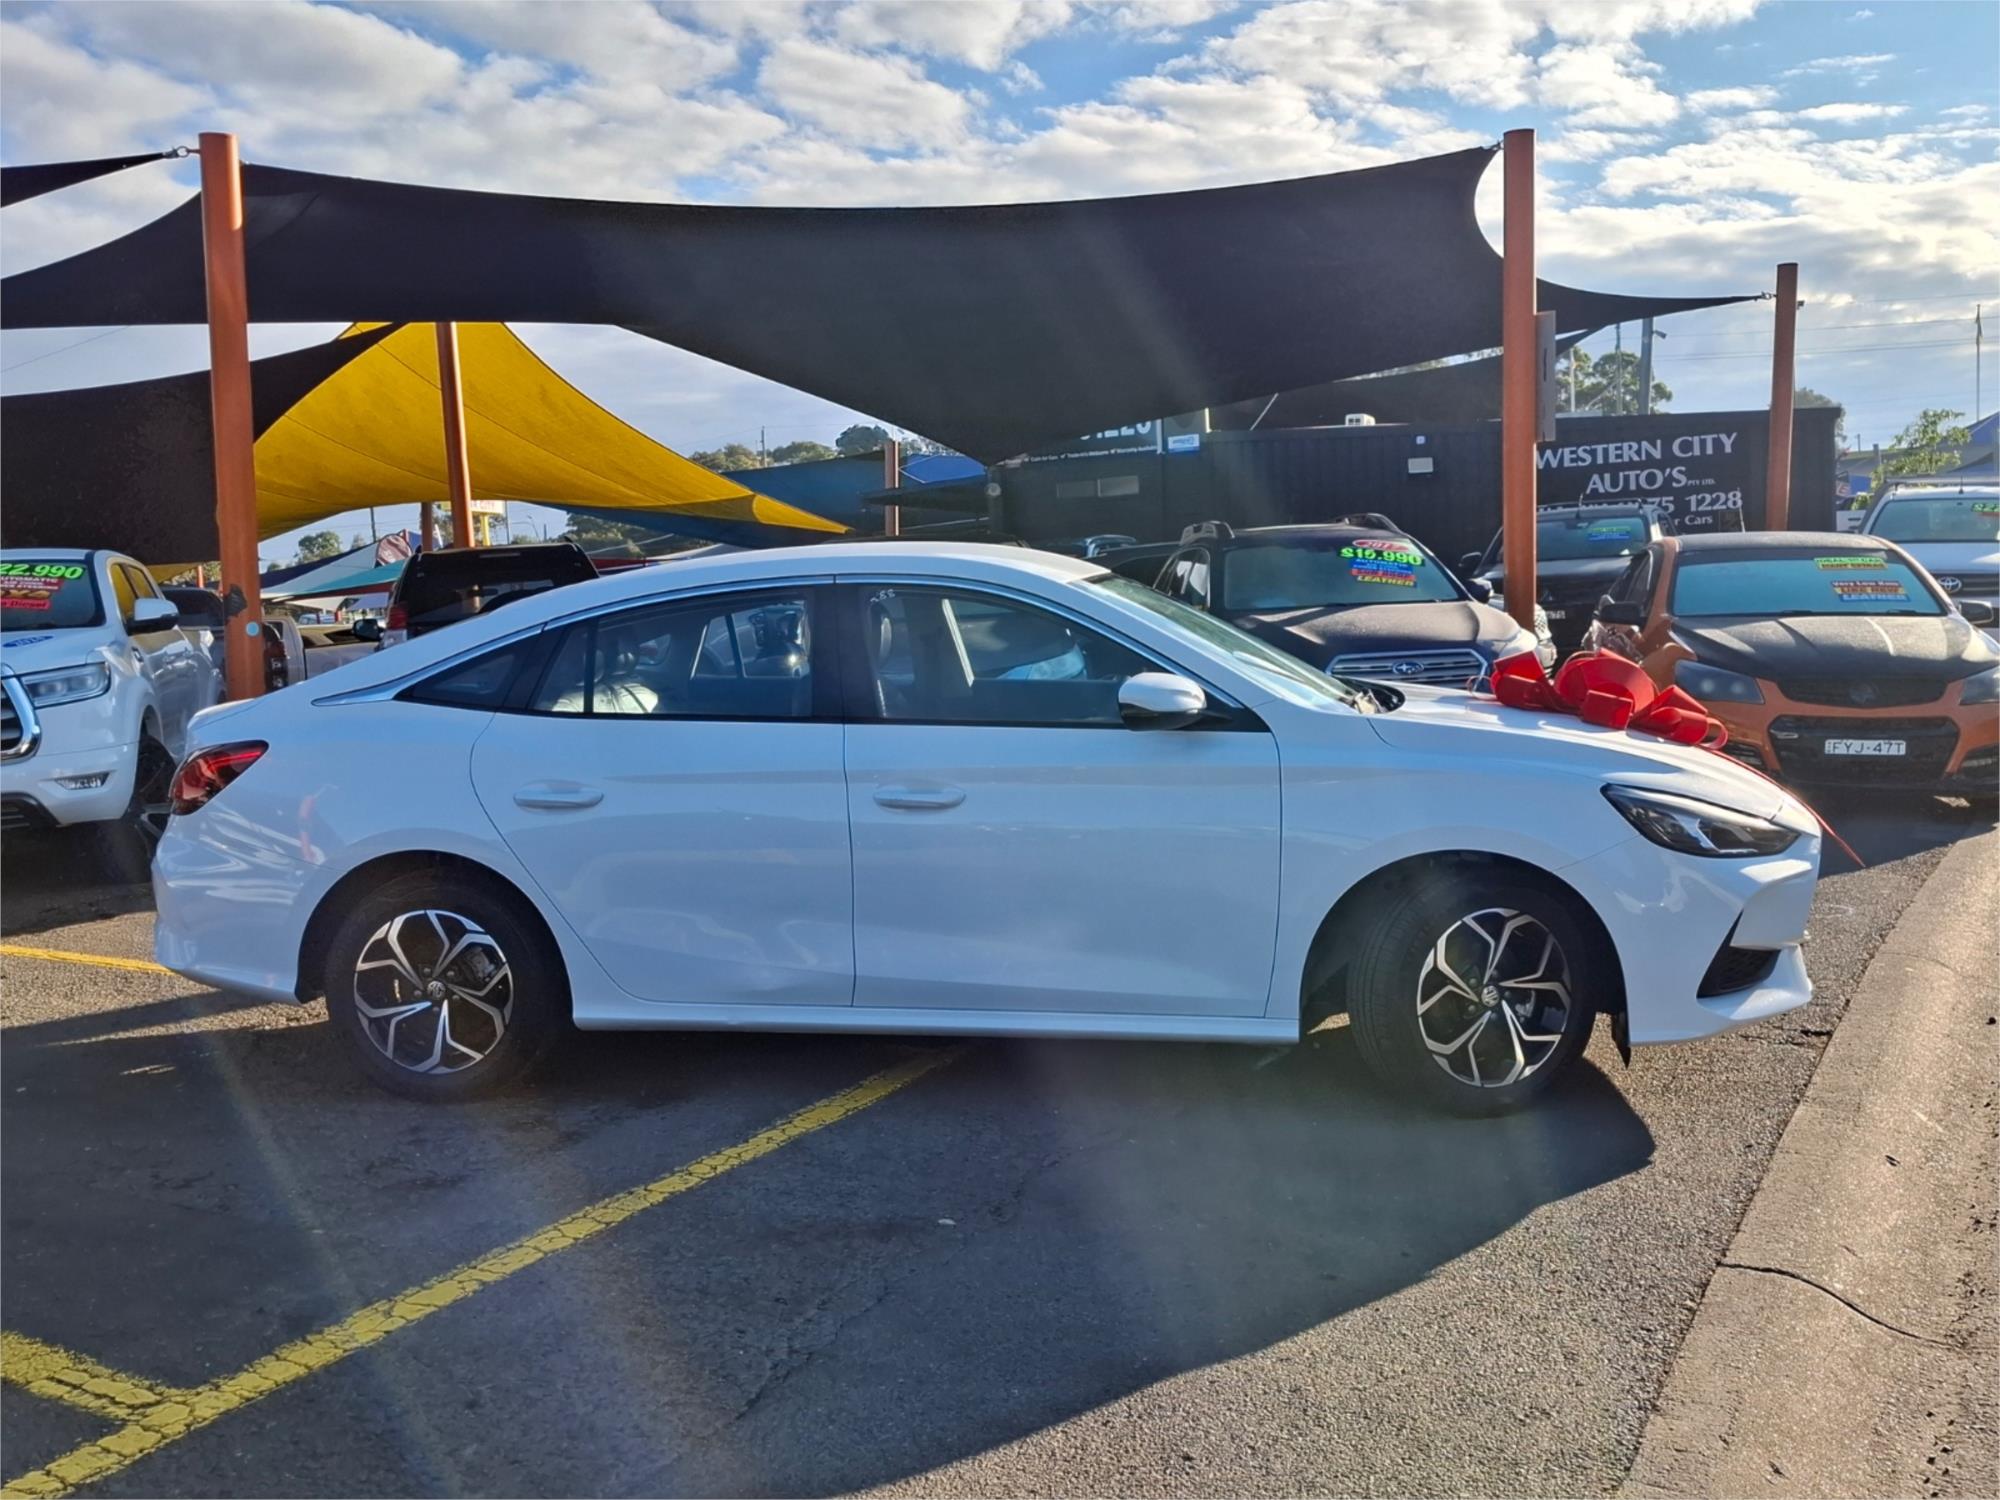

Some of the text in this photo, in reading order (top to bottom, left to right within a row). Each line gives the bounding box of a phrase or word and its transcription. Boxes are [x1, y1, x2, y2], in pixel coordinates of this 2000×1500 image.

[1536, 432, 1738, 469] WESTERN CITY
[1585, 466, 1688, 495] AUTO'S
[1684, 491, 1742, 512] 1228
[1684, 514, 1713, 525] Cars
[1357, 575, 1414, 587] LEATHER
